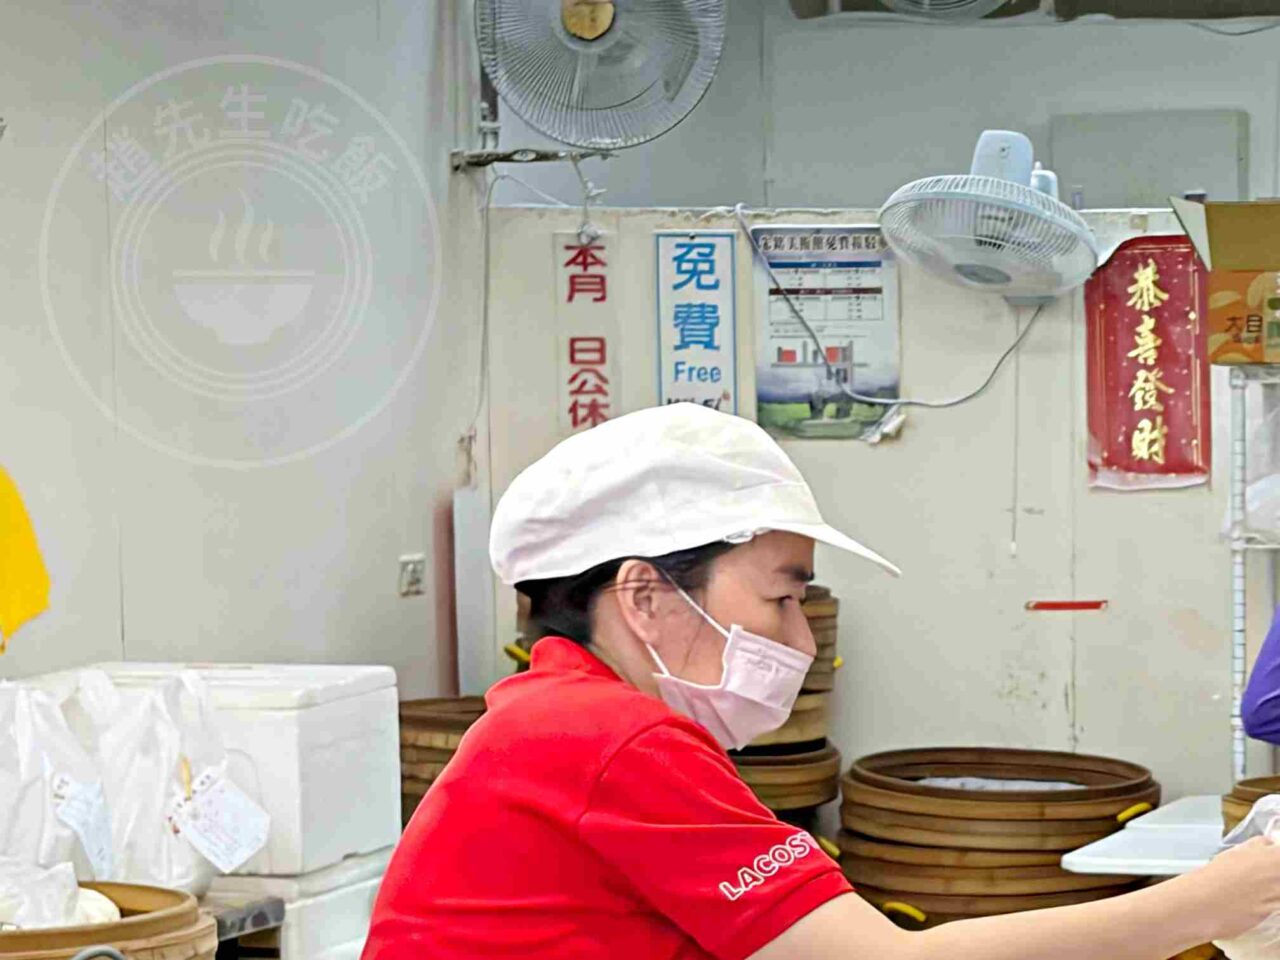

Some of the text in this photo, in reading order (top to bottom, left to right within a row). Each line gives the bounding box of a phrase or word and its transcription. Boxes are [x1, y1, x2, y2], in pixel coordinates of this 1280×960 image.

[563, 244, 608, 303] 本月
[671, 242, 721, 351] 免費
[674, 361, 722, 383] Free
[1126, 257, 1175, 465] 恭喜發財
